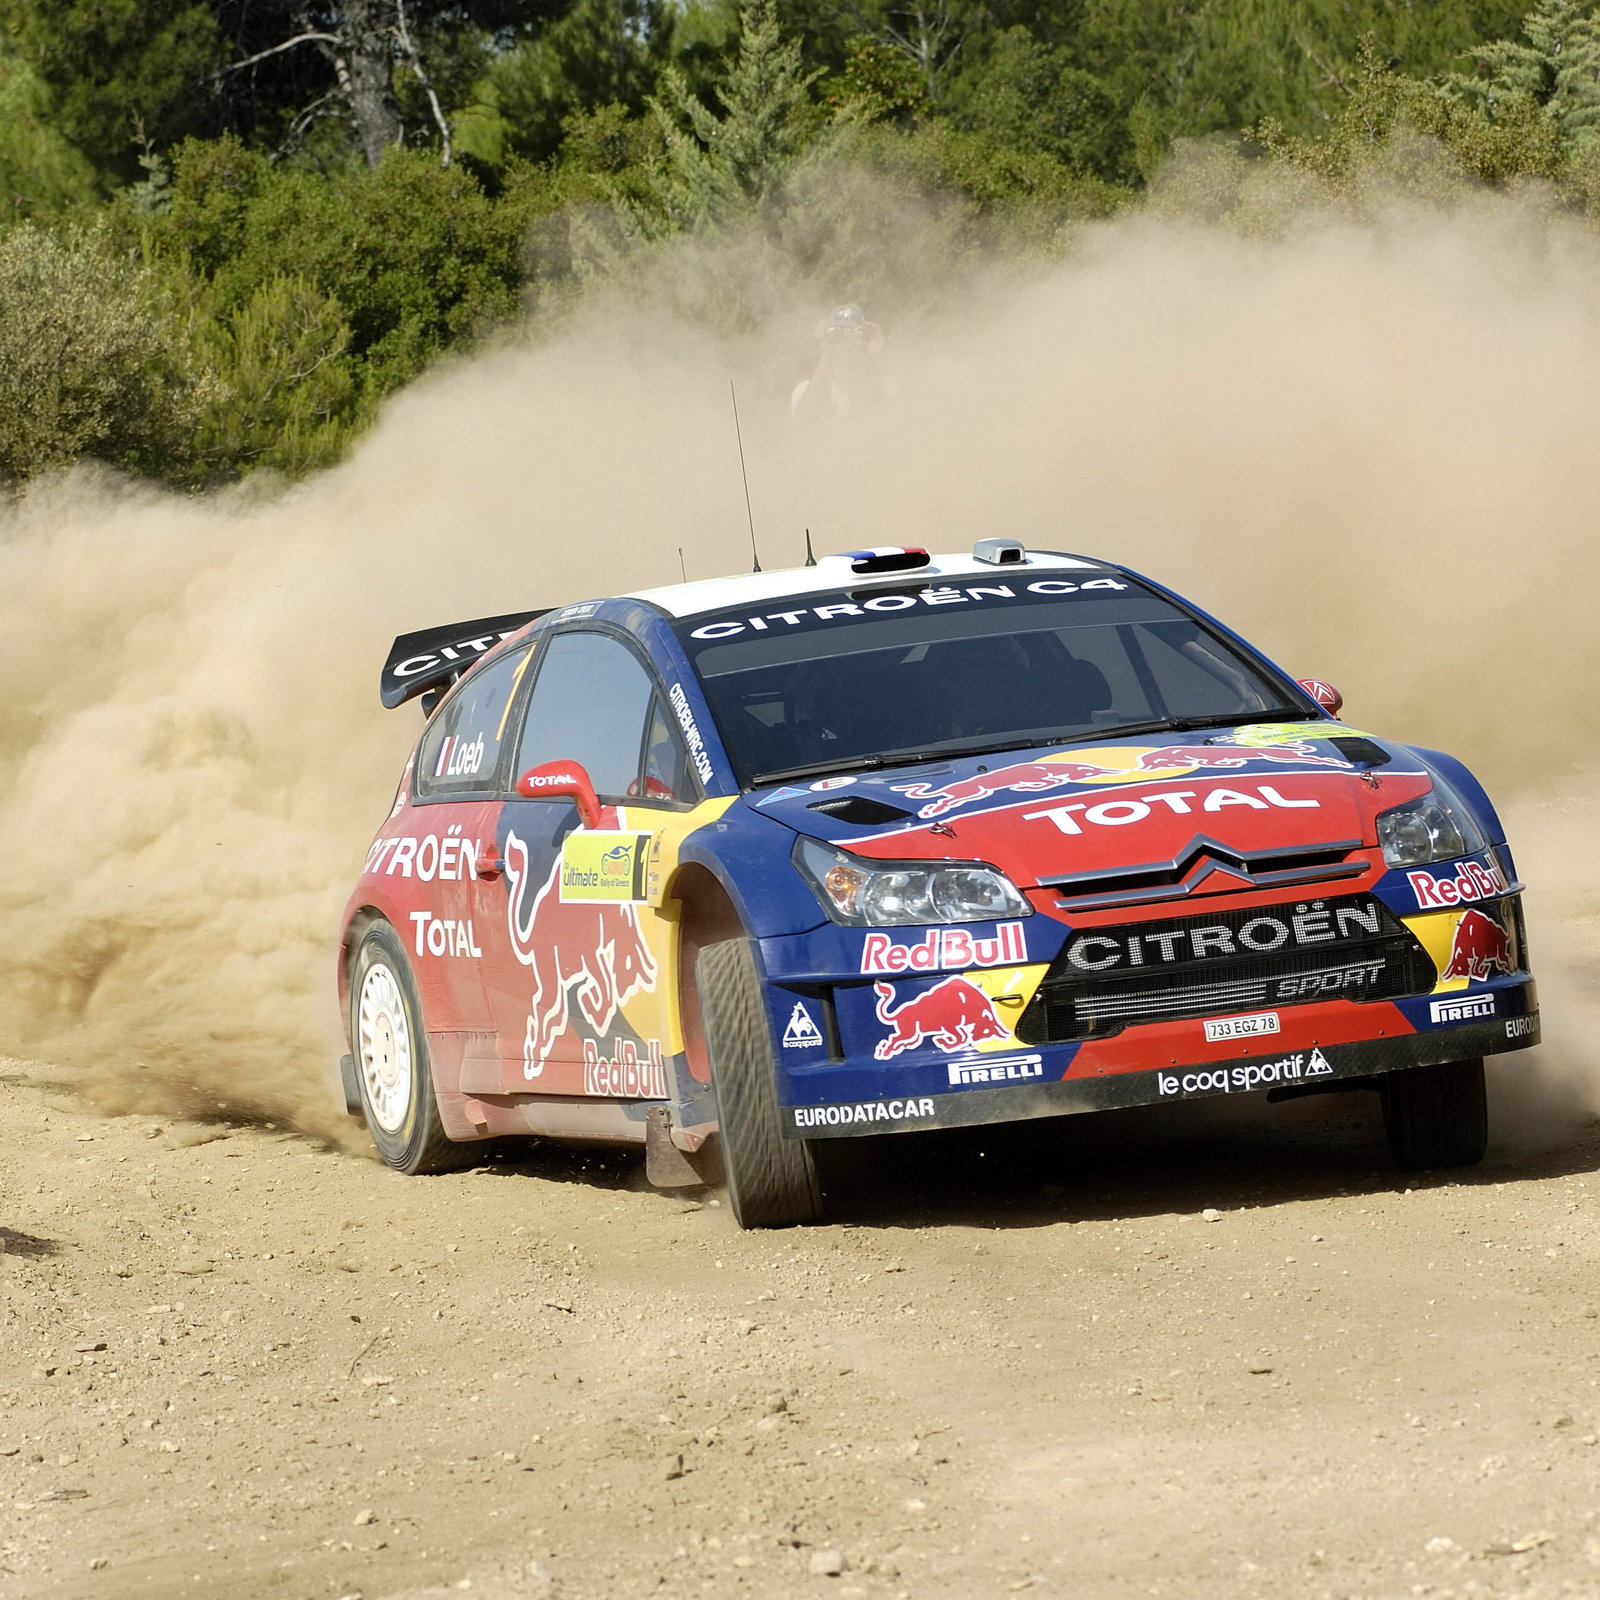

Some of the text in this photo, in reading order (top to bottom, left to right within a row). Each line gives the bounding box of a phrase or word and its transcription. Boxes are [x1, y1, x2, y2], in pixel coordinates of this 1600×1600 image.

[690, 578, 1128, 639] CITROËN C4
[393, 630, 517, 677] CIT
[447, 731, 485, 776] Loeb
[669, 682, 714, 785] CITROEN-WRC.COM
[527, 774, 577, 788] TOTAL
[1022, 785, 1321, 835] TOTAL
[563, 867, 598, 887] ultimate
[1406, 862, 1481, 909] Red
[410, 911, 482, 957] TOTAL
[860, 921, 1028, 974] Red Bull
[1066, 900, 1379, 971] CITROËN
[1276, 965, 1385, 997] SPORT
[1211, 1017, 1275, 1037] 733 EGZ 78
[1429, 993, 1496, 1023] PIRELLI
[583, 1036, 667, 1098] Red Bull
[947, 1053, 1043, 1085] PIRELLI
[1158, 1054, 1304, 1095] le coq sportif
[794, 1098, 935, 1127] EURODATACAR
